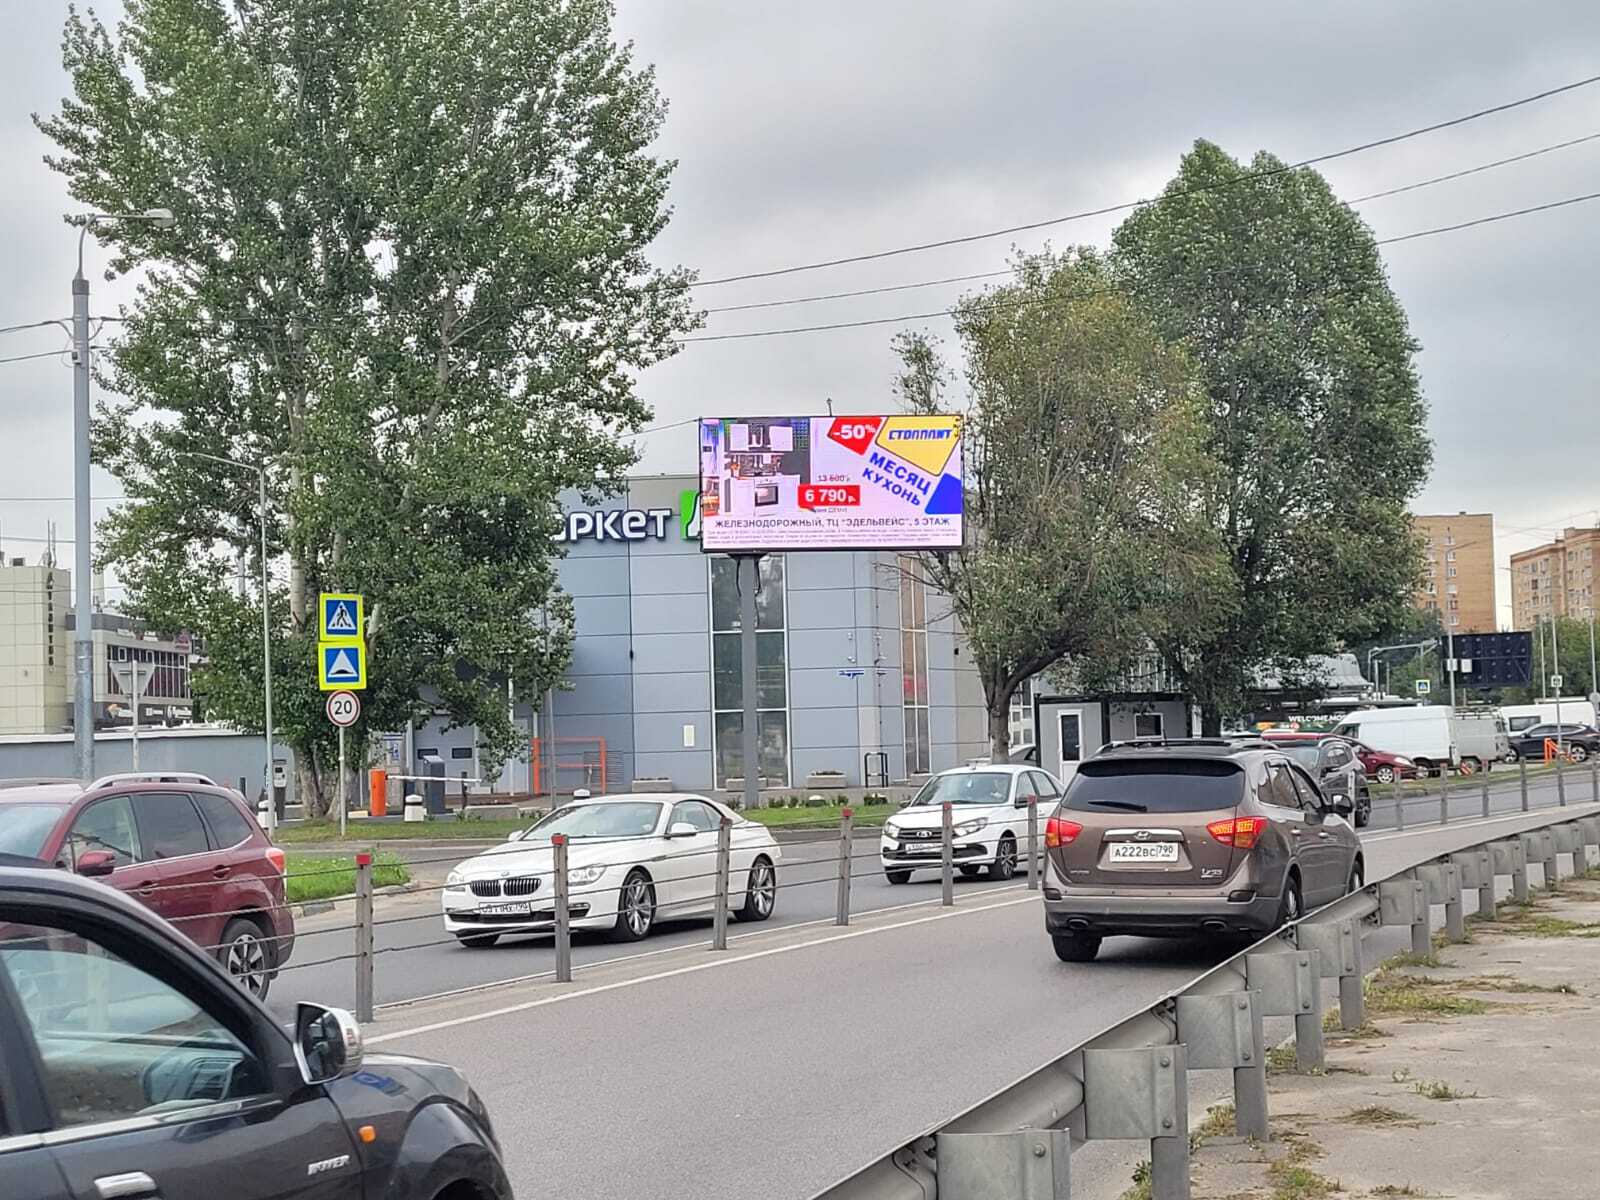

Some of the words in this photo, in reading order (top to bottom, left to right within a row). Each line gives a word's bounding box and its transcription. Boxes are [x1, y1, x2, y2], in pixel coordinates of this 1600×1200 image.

[833, 424, 878, 440] -50%
[869, 452, 931, 495] МЕСЯЦ
[862, 467, 921, 506] КУХОНЬ
[805, 489, 814, 502] 6
[819, 488, 847, 502] 790
[715, 517, 825, 528] ЖЕЛЕЗНОДОРОЖНЫЙ,
[827, 518, 839, 528] ТЦ
[922, 517, 950, 527] ЭТАЖ
[334, 700, 353, 715] 20
